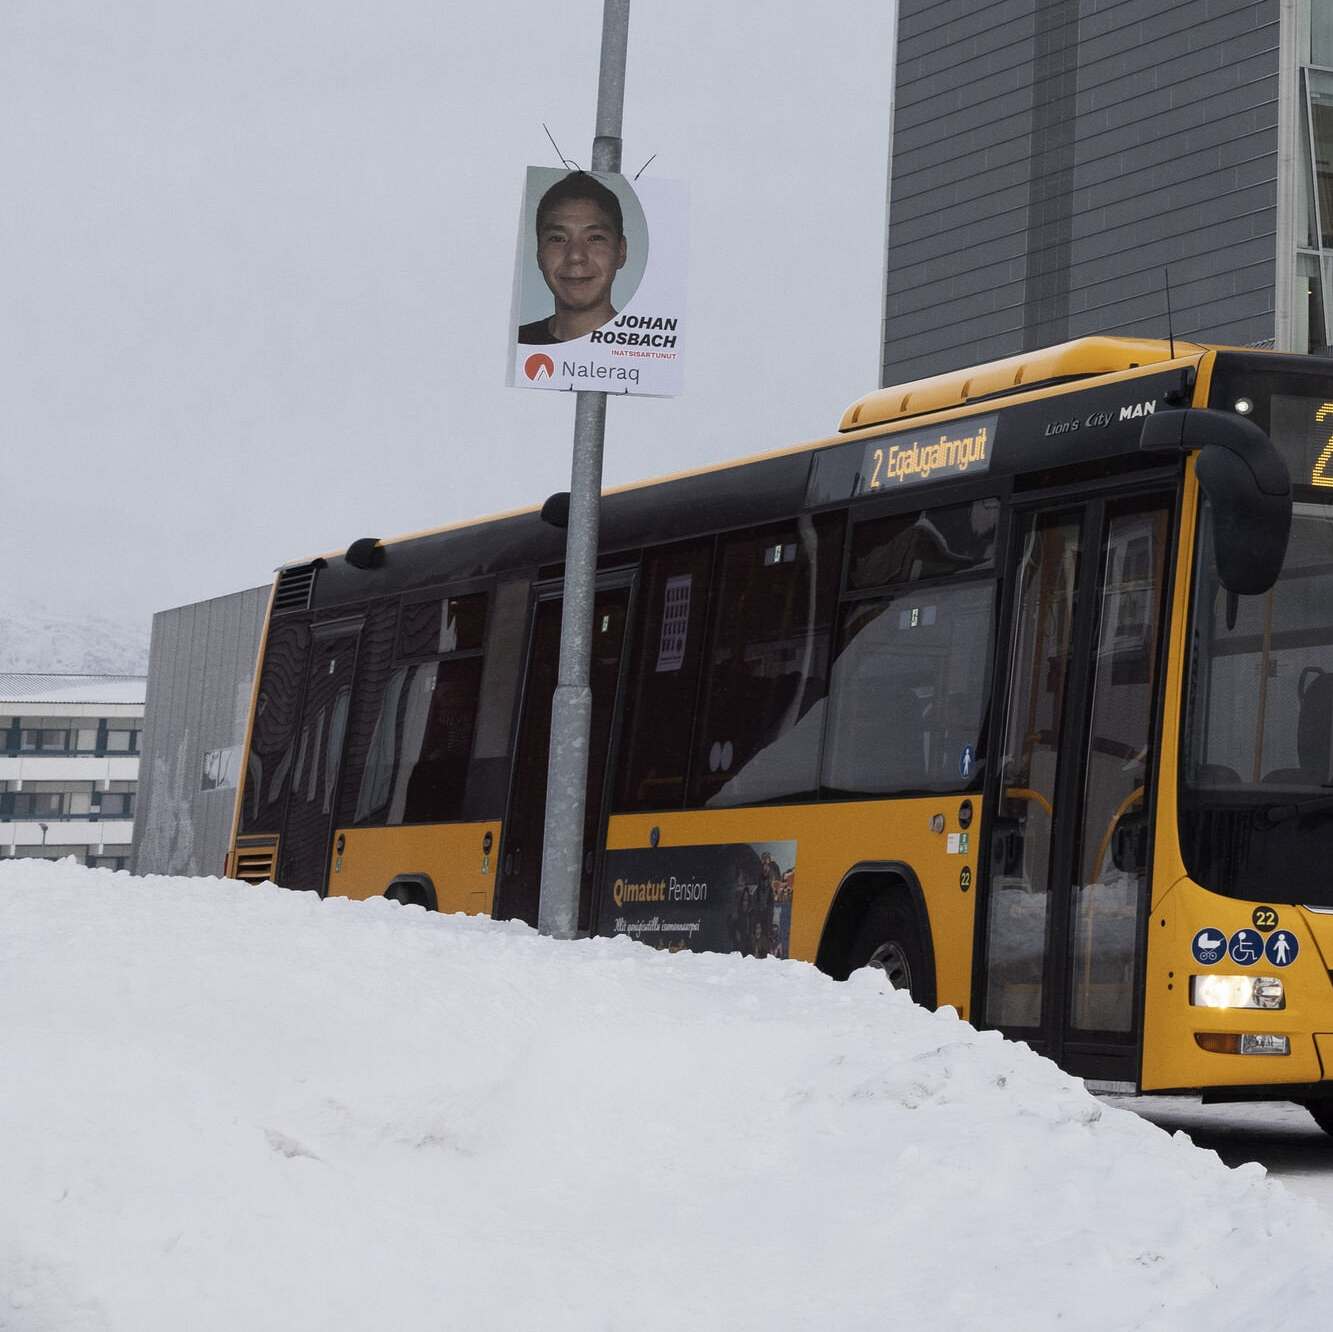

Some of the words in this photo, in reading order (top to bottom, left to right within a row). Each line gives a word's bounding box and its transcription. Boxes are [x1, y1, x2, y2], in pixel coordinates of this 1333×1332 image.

[614, 315, 678, 331] JOHAN
[590, 330, 677, 348] ROSBACH
[611, 349, 677, 360] INATSISARTUNUT
[562, 361, 639, 385] Naleraq
[1045, 418, 1080, 436] Lion's
[1085, 411, 1114, 428] City
[1119, 400, 1156, 421] MAN
[870, 449, 883, 488] 2
[887, 428, 987, 482] Eqalugalinnguit
[961, 872, 970, 885] 22
[613, 878, 665, 907] Qimatut
[668, 876, 707, 901] Pension
[1256, 912, 1275, 925] 22
